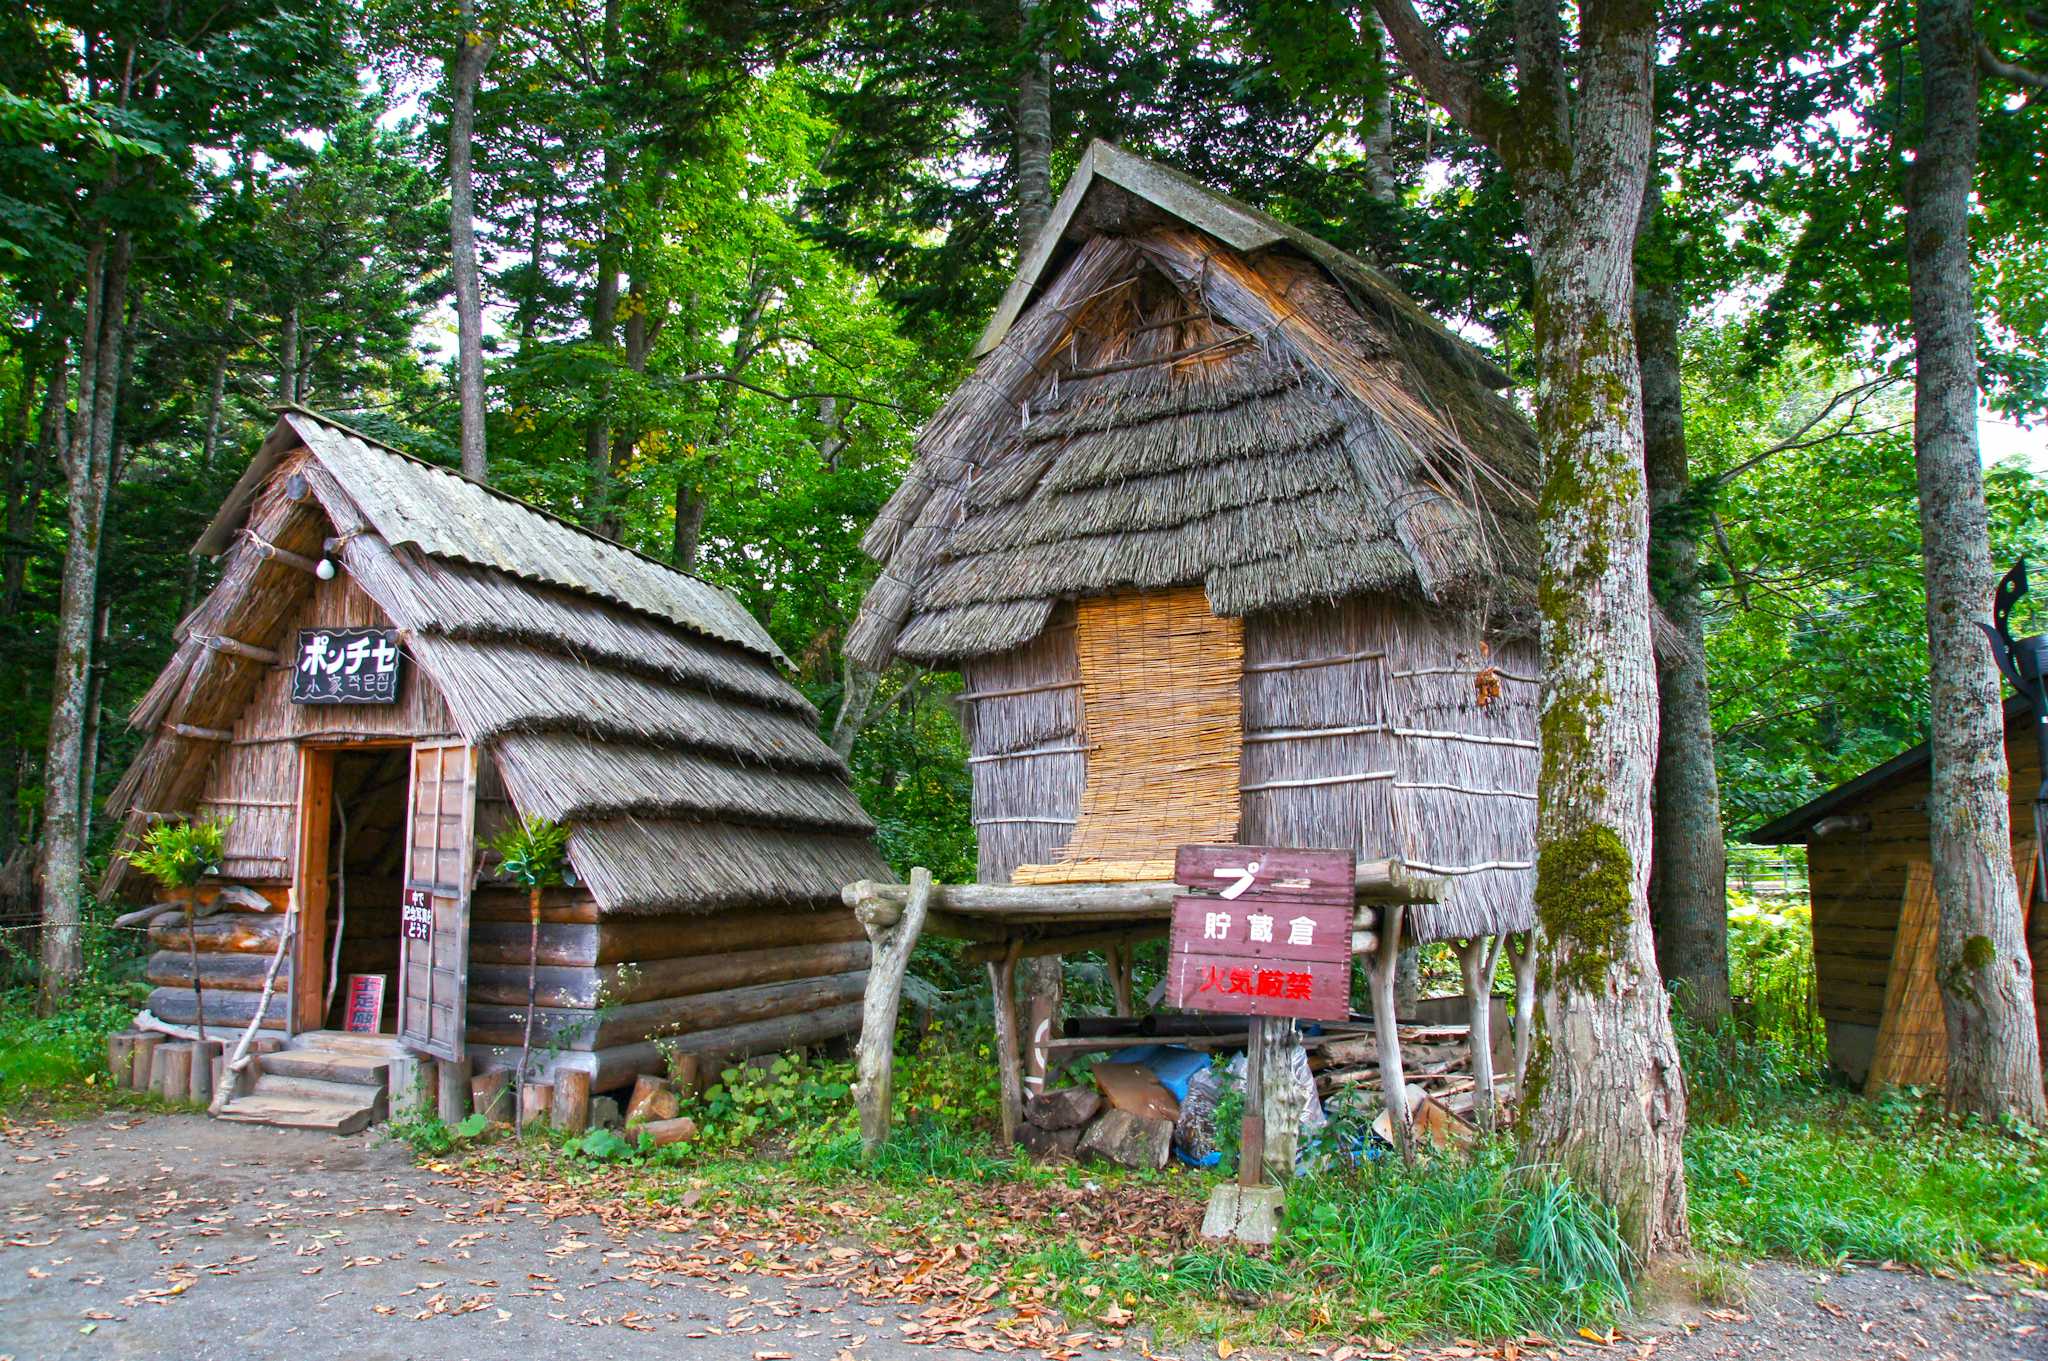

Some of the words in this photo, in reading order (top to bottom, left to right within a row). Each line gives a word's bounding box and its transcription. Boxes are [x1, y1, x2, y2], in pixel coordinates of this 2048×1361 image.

[301, 635, 396, 675] ポンチセ
[349, 673, 390, 692] 작은집
[408, 922, 427, 939] どうぞ
[1204, 912, 1317, 945] 貯蔵倉
[1199, 962, 1313, 1000] 火気厳禁
